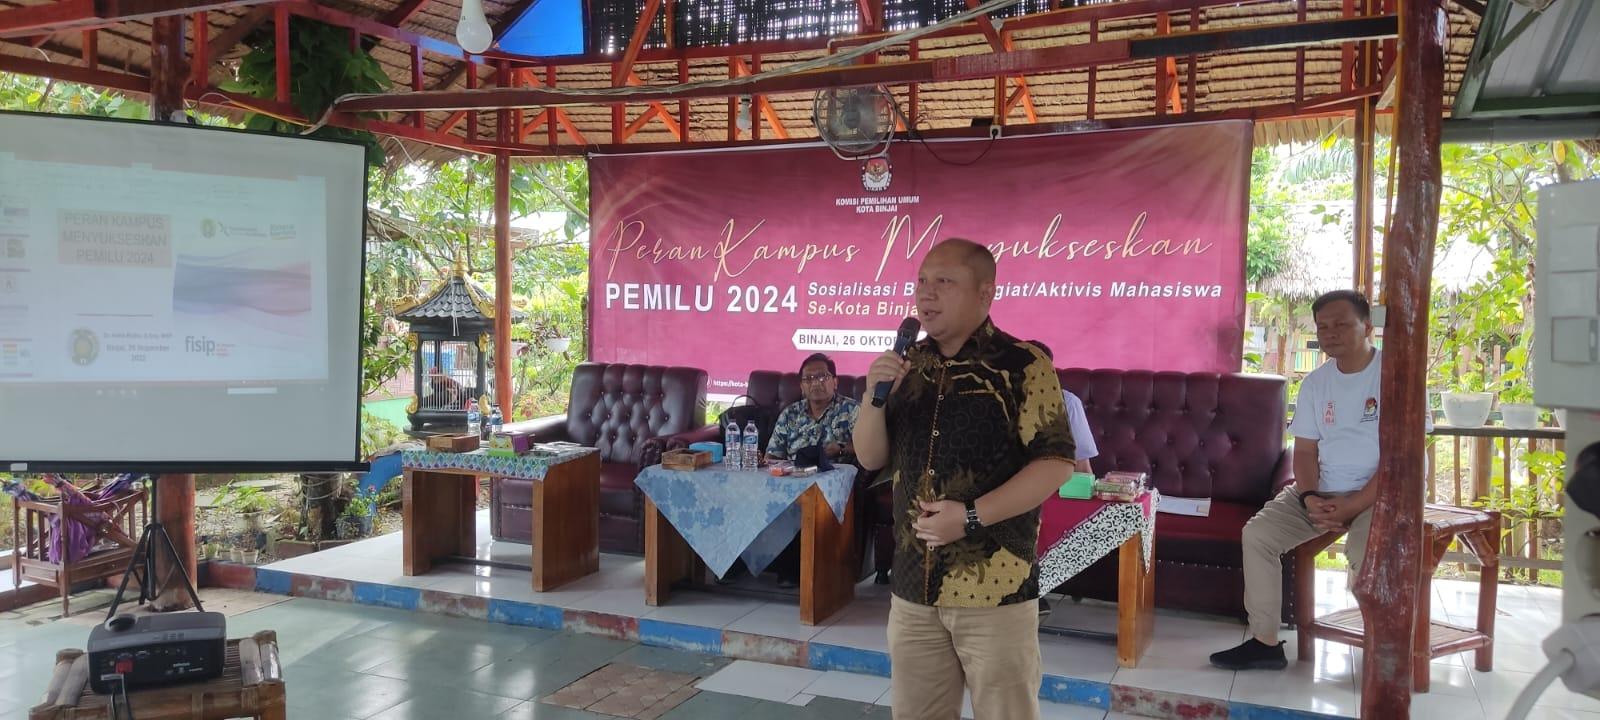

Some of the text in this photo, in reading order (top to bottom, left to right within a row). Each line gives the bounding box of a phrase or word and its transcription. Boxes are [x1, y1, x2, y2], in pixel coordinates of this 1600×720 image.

[835, 195, 920, 206] KOMISI PEMILIHAN UMUM
[856, 204, 898, 213] KOTA BINJAI
[64, 213, 164, 229] PERAN KAMPUS
[63, 230, 168, 247] MENYUKSESKAN
[607, 210, 1213, 282] Peran Kampus Myukseskan
[76, 248, 155, 265] PEMILU 2024
[606, 283, 798, 313] PEMILU 2024
[807, 281, 898, 297] Sosialisasi
[994, 281, 1102, 301] giat/Aktivis
[1110, 281, 1223, 298] Mahasiswa
[807, 300, 919, 320] Se-Kota Binja
[185, 335, 216, 357] fisip
[799, 334, 898, 347] BINJAI, 26 OKTO
